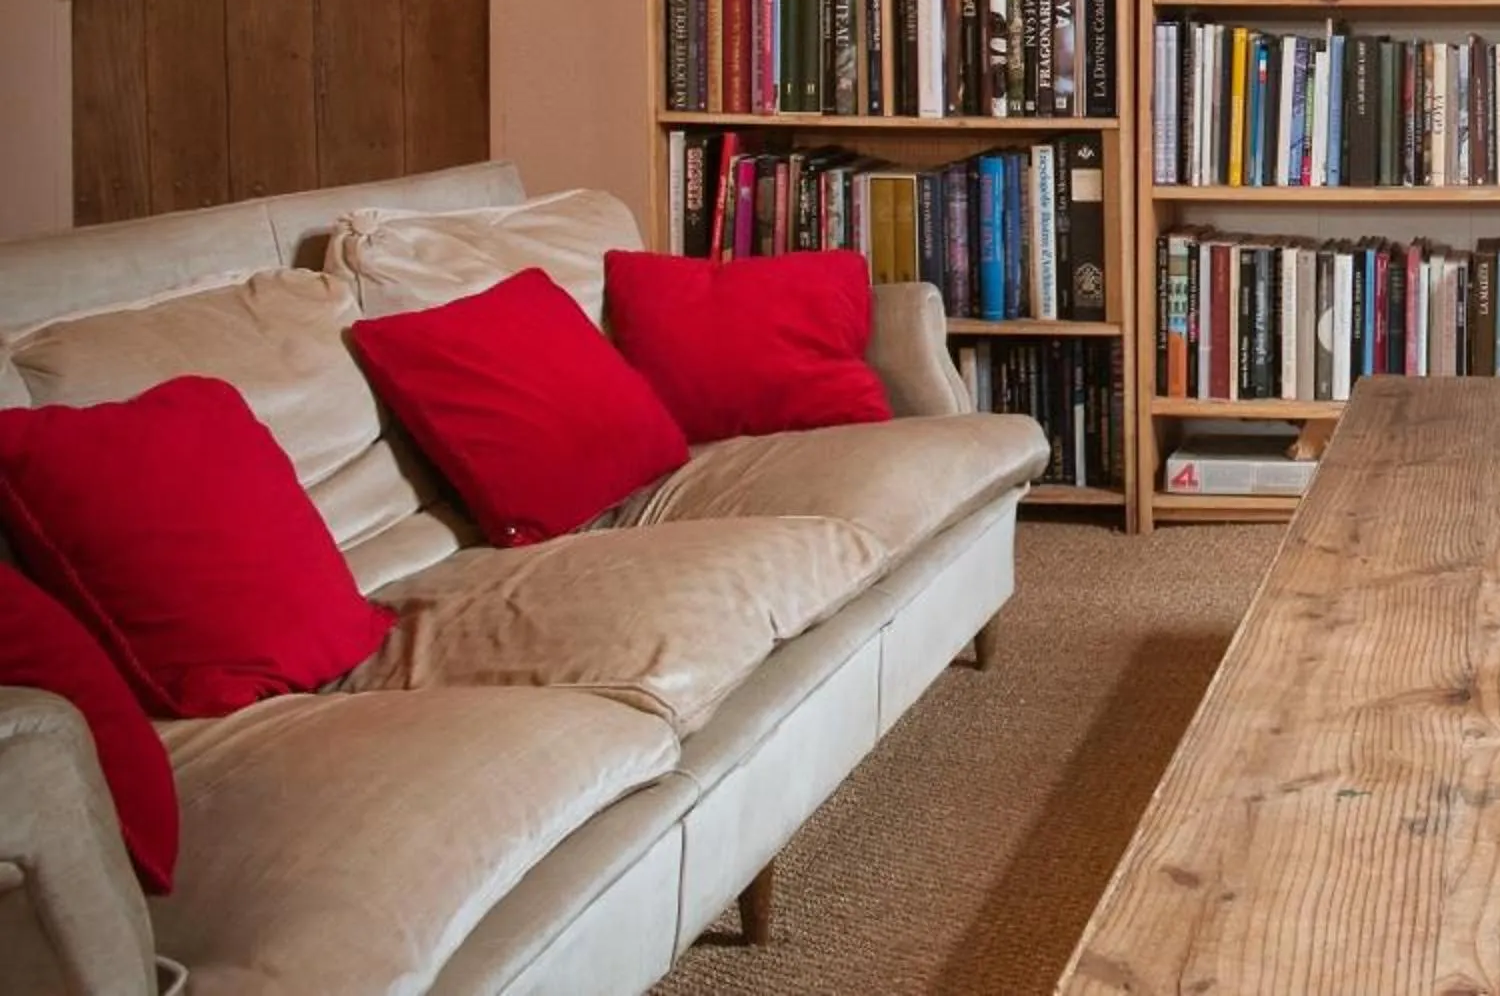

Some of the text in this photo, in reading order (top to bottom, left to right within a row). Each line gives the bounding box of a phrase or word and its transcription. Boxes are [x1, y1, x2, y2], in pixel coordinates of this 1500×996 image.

[1093, 34, 1106, 79] DIVINE
[1093, 80, 1106, 97] LA
[687, 147, 703, 211] CIRCUS
[1170, 463, 1199, 489] 4
